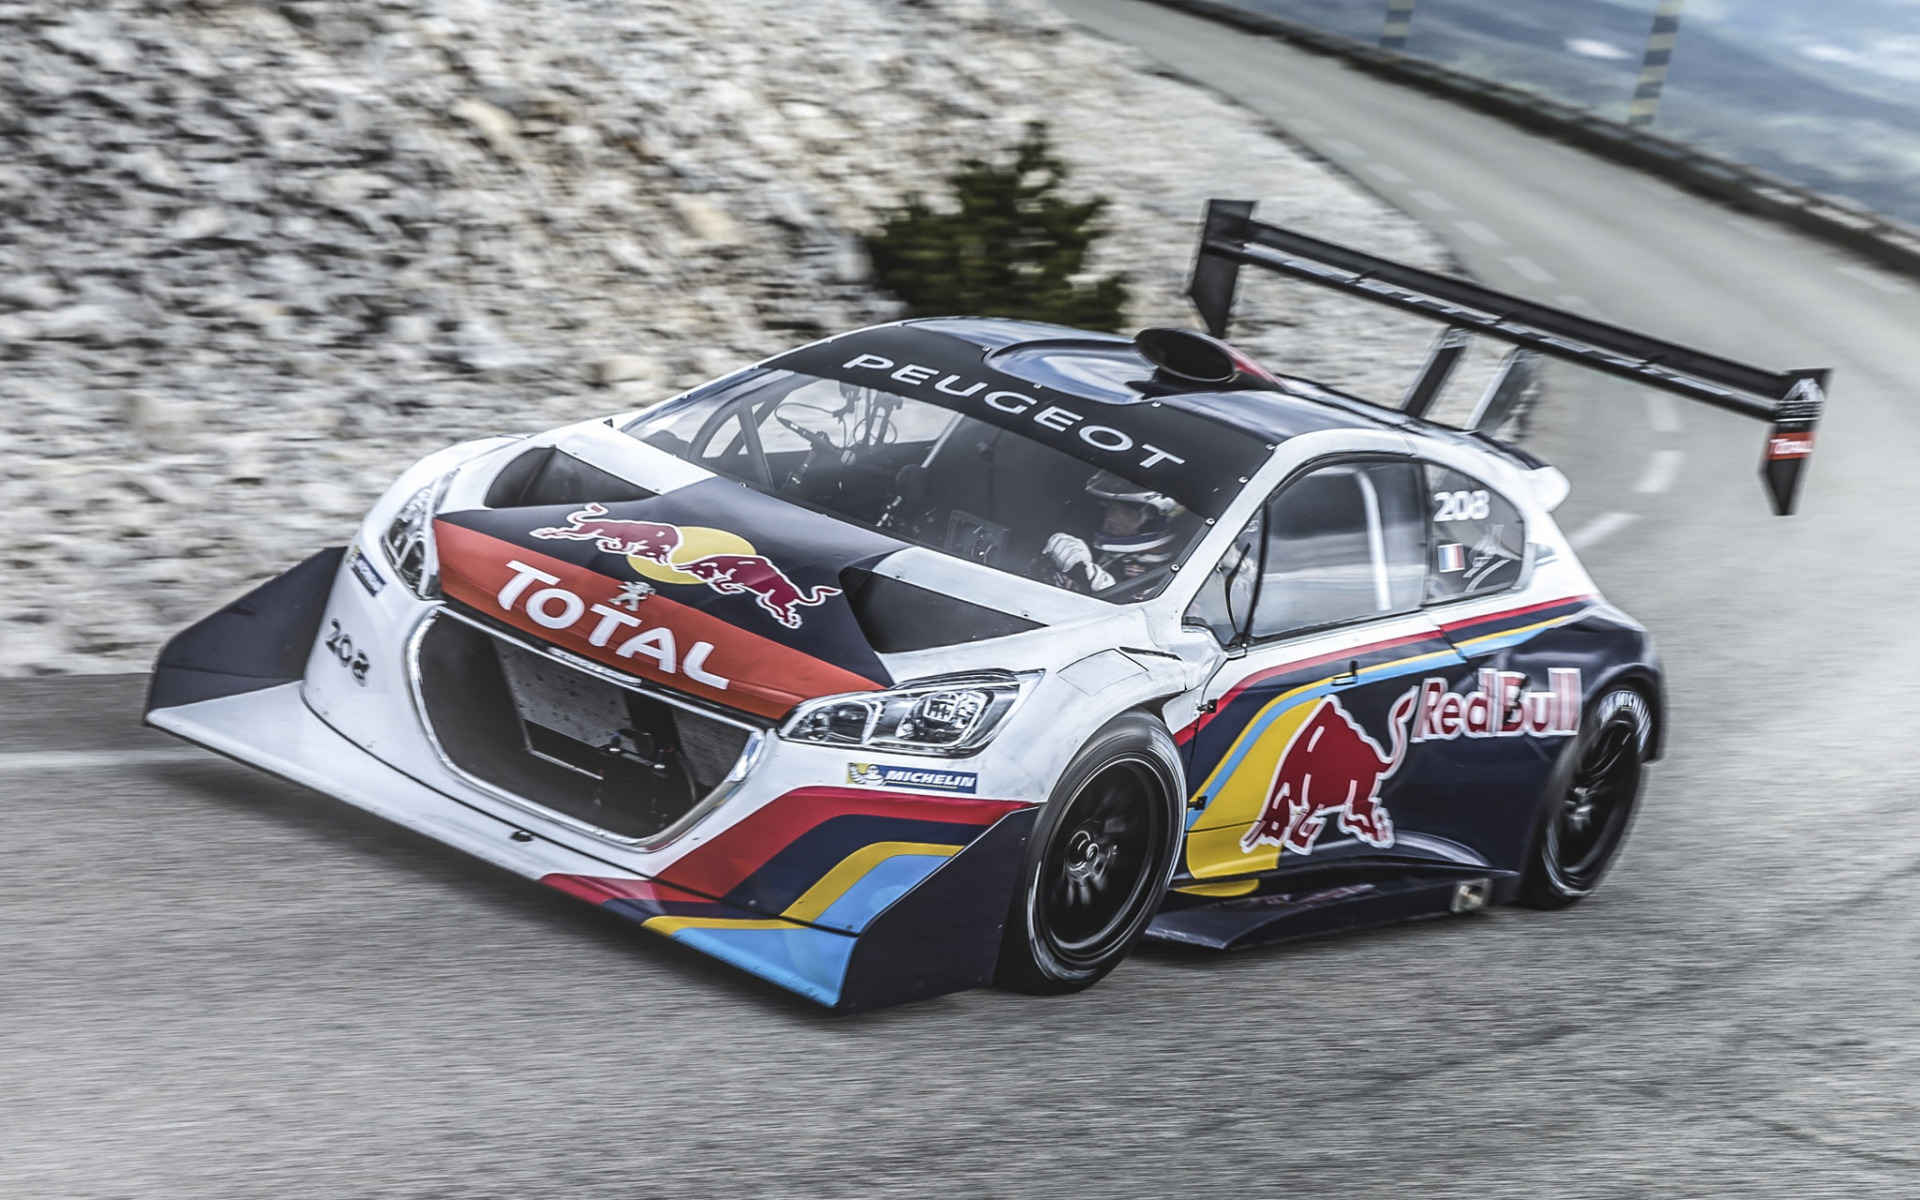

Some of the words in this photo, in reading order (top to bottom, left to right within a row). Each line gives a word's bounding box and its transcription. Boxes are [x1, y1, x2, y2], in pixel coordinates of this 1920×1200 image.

[842, 353, 1185, 469] PEUGEOT
[1433, 490, 1490, 521] 208
[325, 617, 370, 687] 208
[498, 560, 730, 690] TOTAL
[884, 770, 976, 788] MICHELIN
